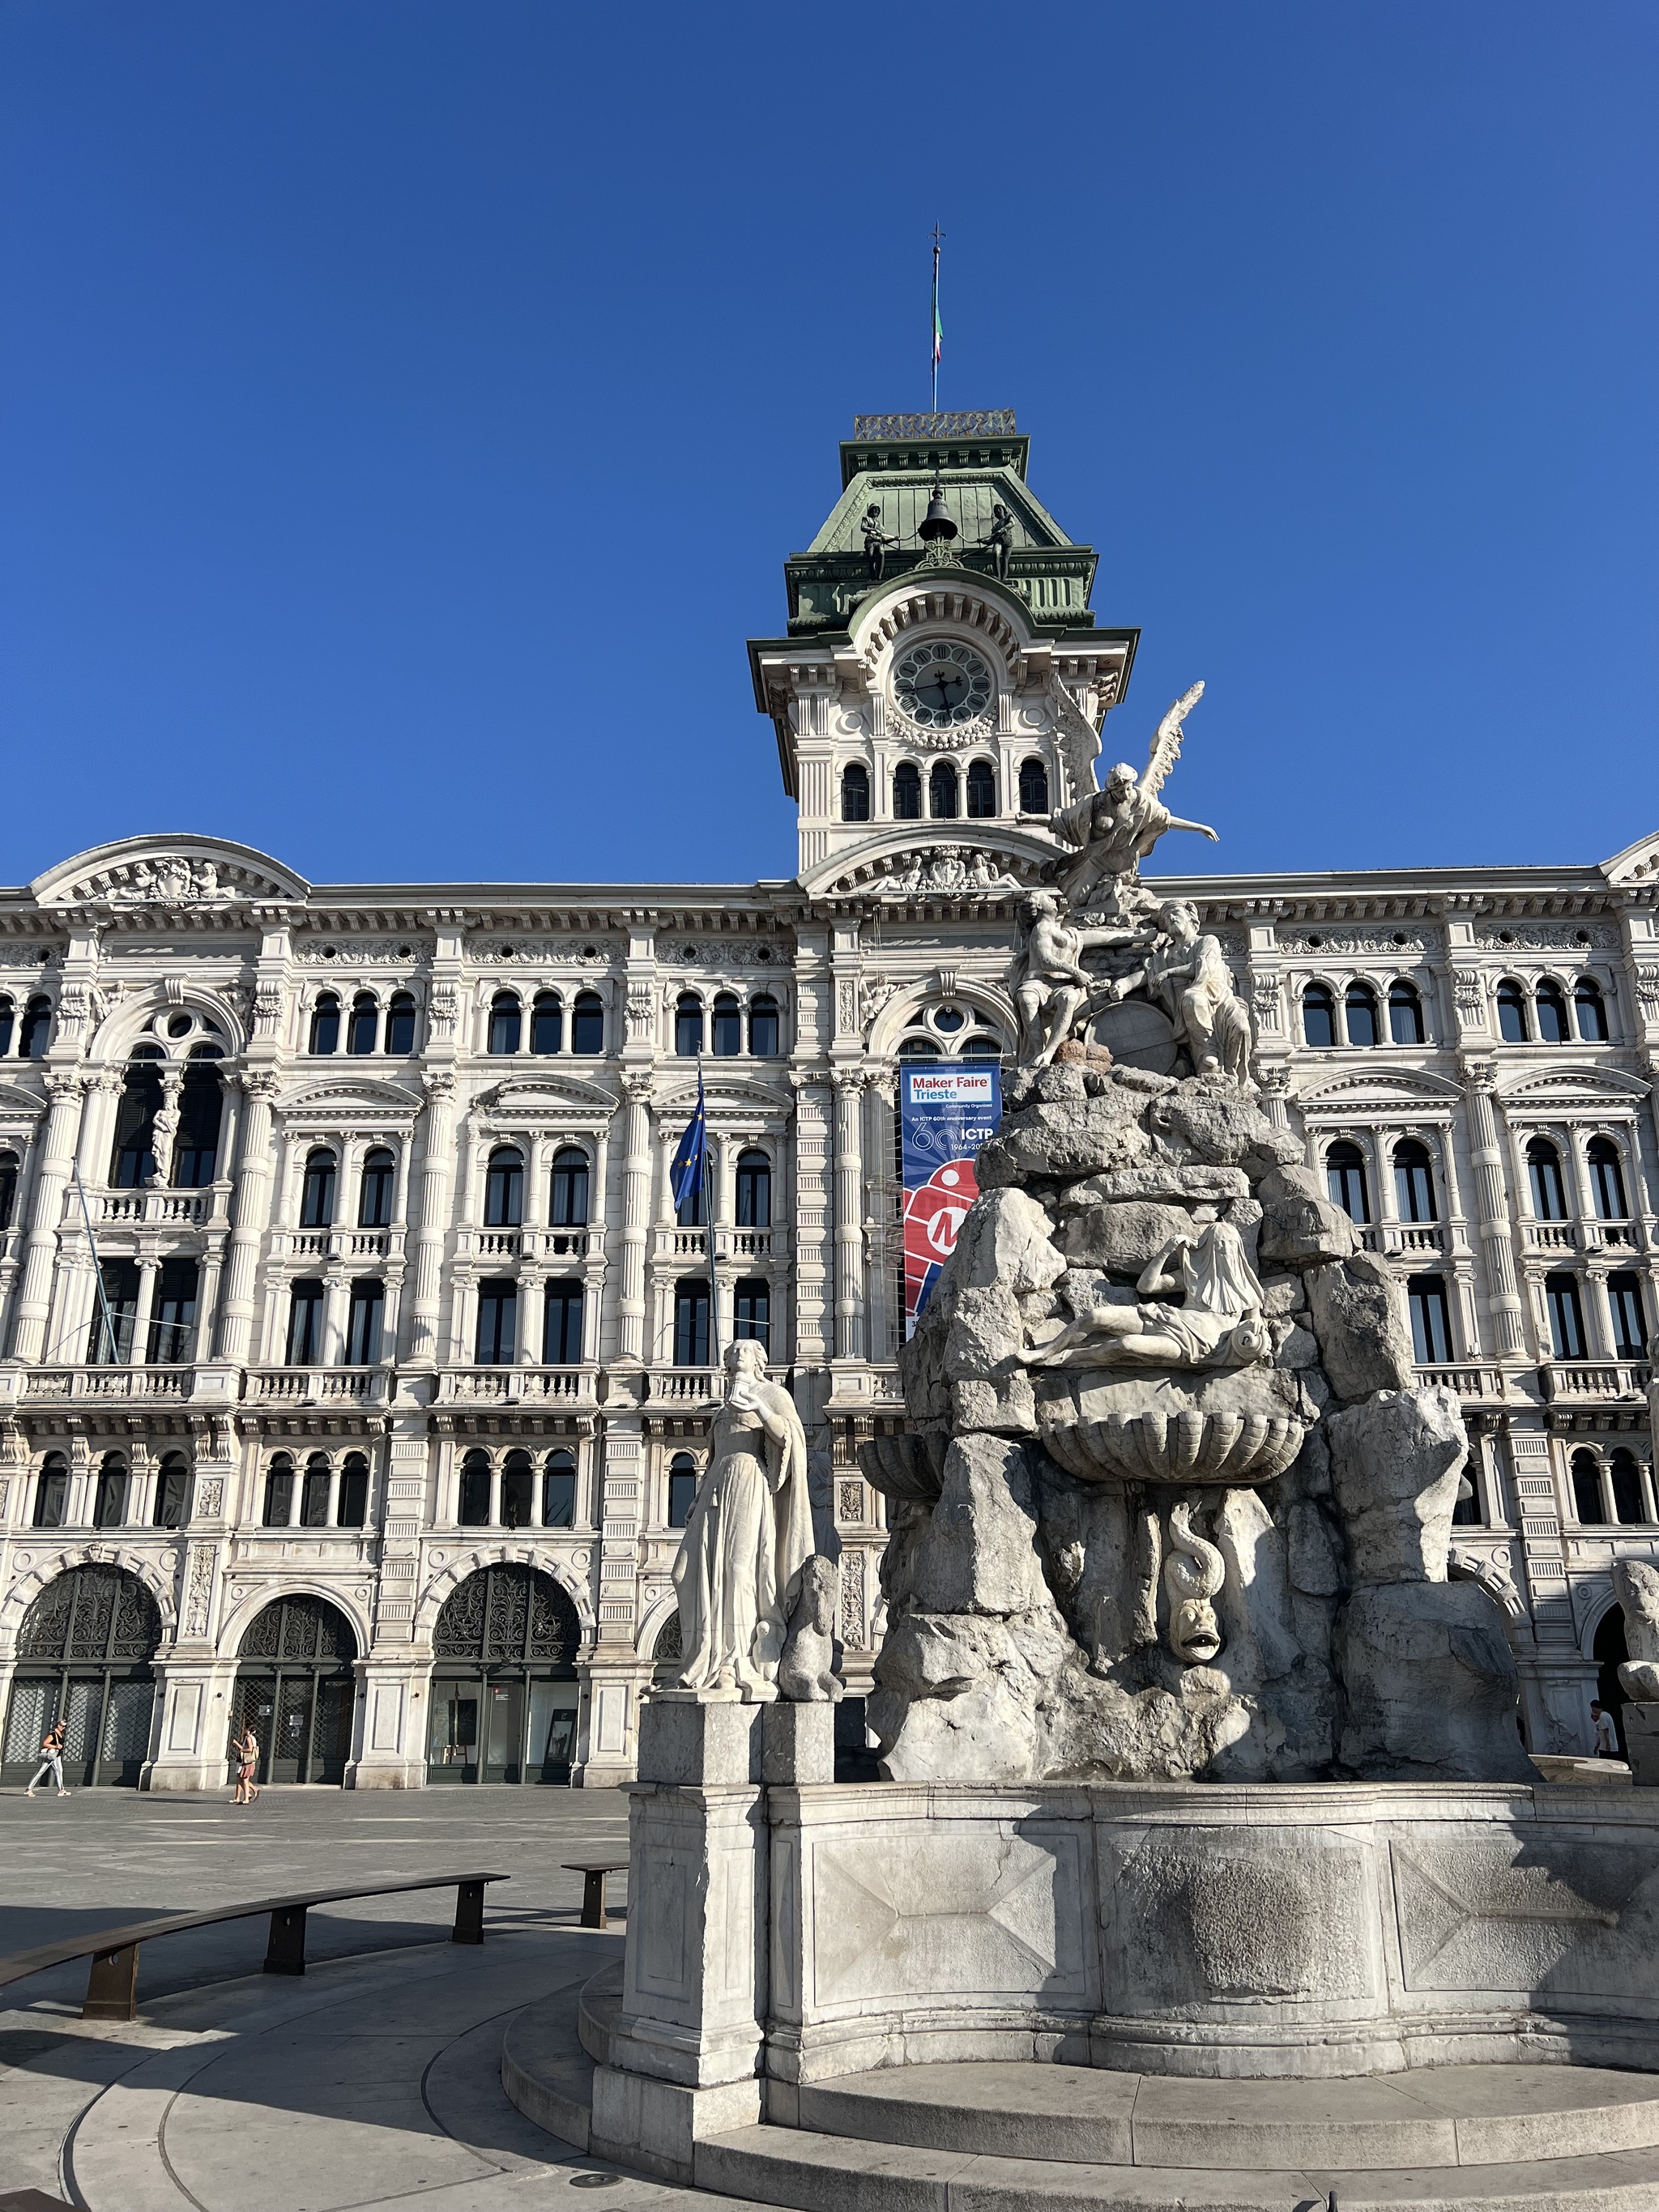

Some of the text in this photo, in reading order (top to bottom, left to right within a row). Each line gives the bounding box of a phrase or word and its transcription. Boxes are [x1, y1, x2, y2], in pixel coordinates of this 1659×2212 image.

[913, 1076, 987, 1088] Maker Faire
[914, 1089, 957, 1099] Trieste
[961, 1127, 994, 1140] ICTP
